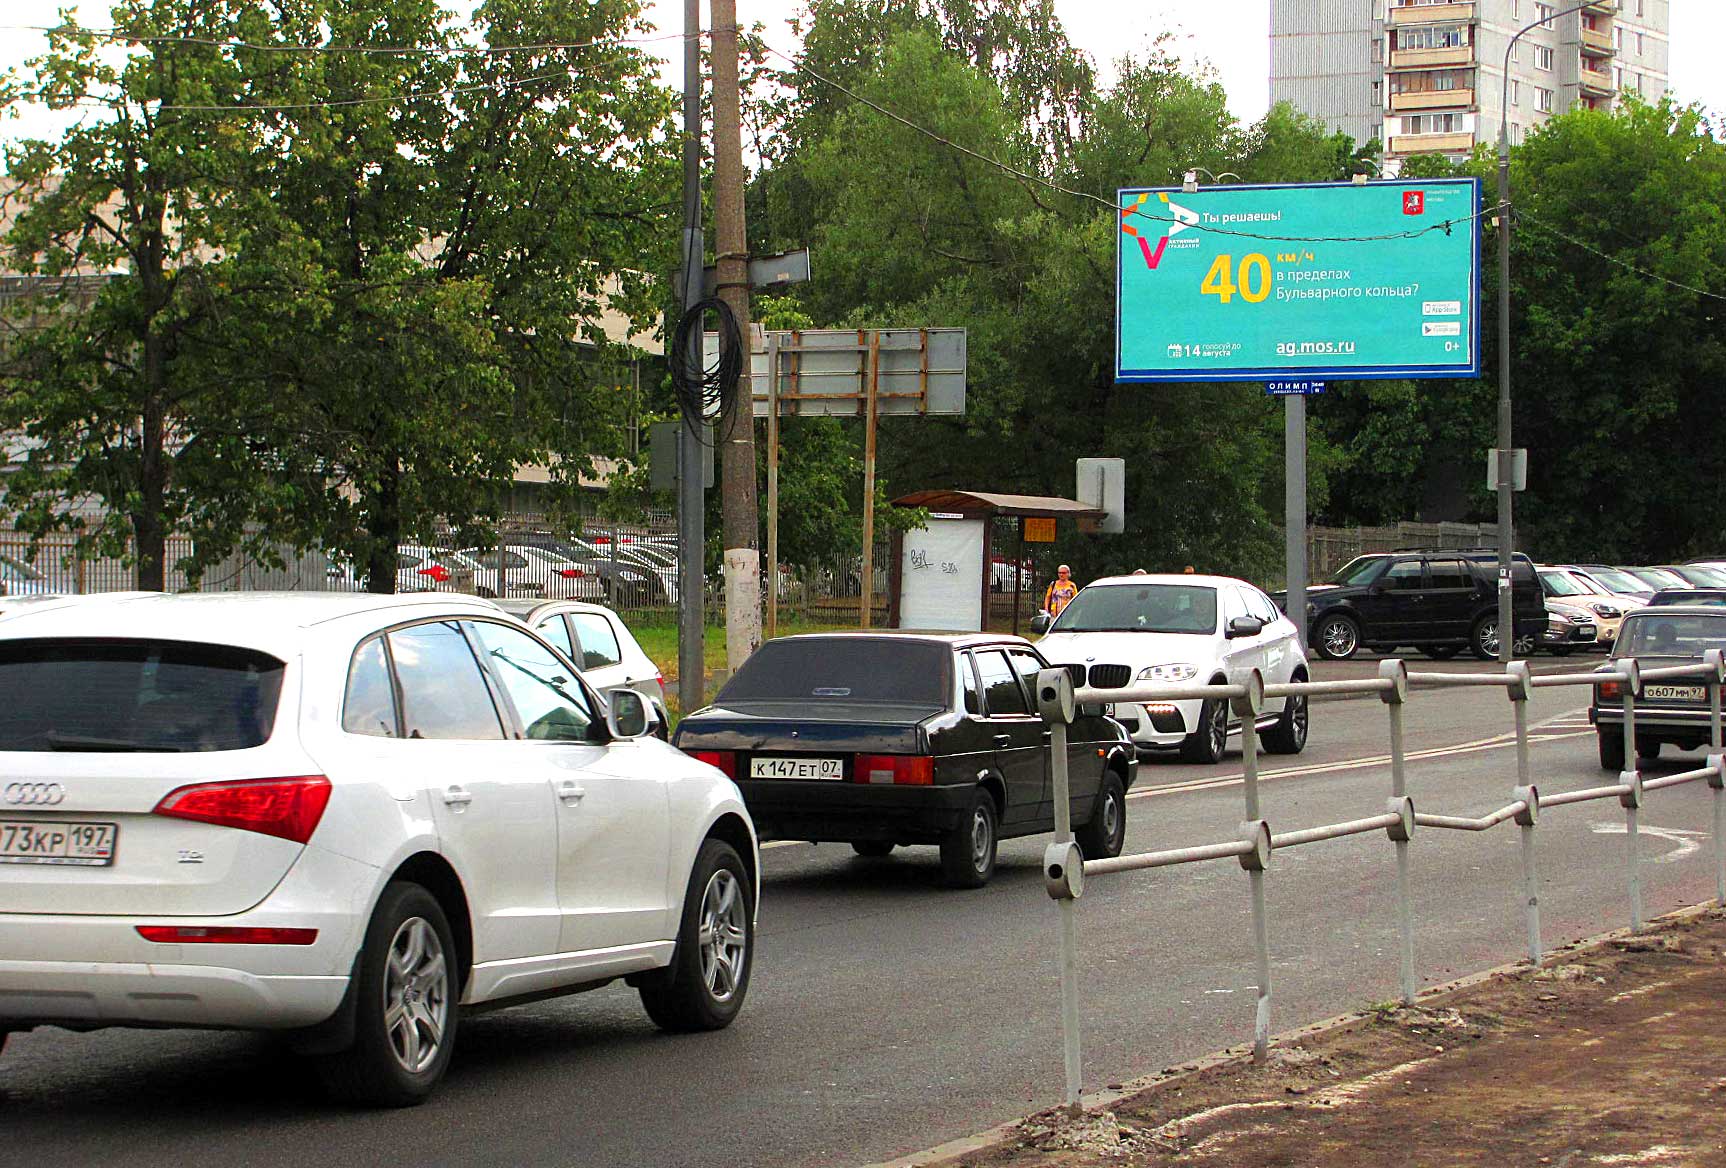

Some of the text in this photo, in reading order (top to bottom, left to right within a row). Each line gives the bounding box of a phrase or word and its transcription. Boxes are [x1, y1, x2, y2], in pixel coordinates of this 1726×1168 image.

[1202, 210, 1281, 225] Ты решаешь!
[1276, 250, 1315, 265] км/ч
[1200, 253, 1272, 304] 40
[1277, 269, 1351, 284] в пределах
[1276, 284, 1419, 302] Бульварного кольца?
[1184, 344, 1201, 357] 14
[1202, 349, 1231, 358] августа
[1276, 341, 1356, 356] ag.mos.ru
[1445, 341, 1460, 352] 0+
[1269, 382, 1308, 390] ОЛИМП
[0, 825, 65, 852] 73КР
